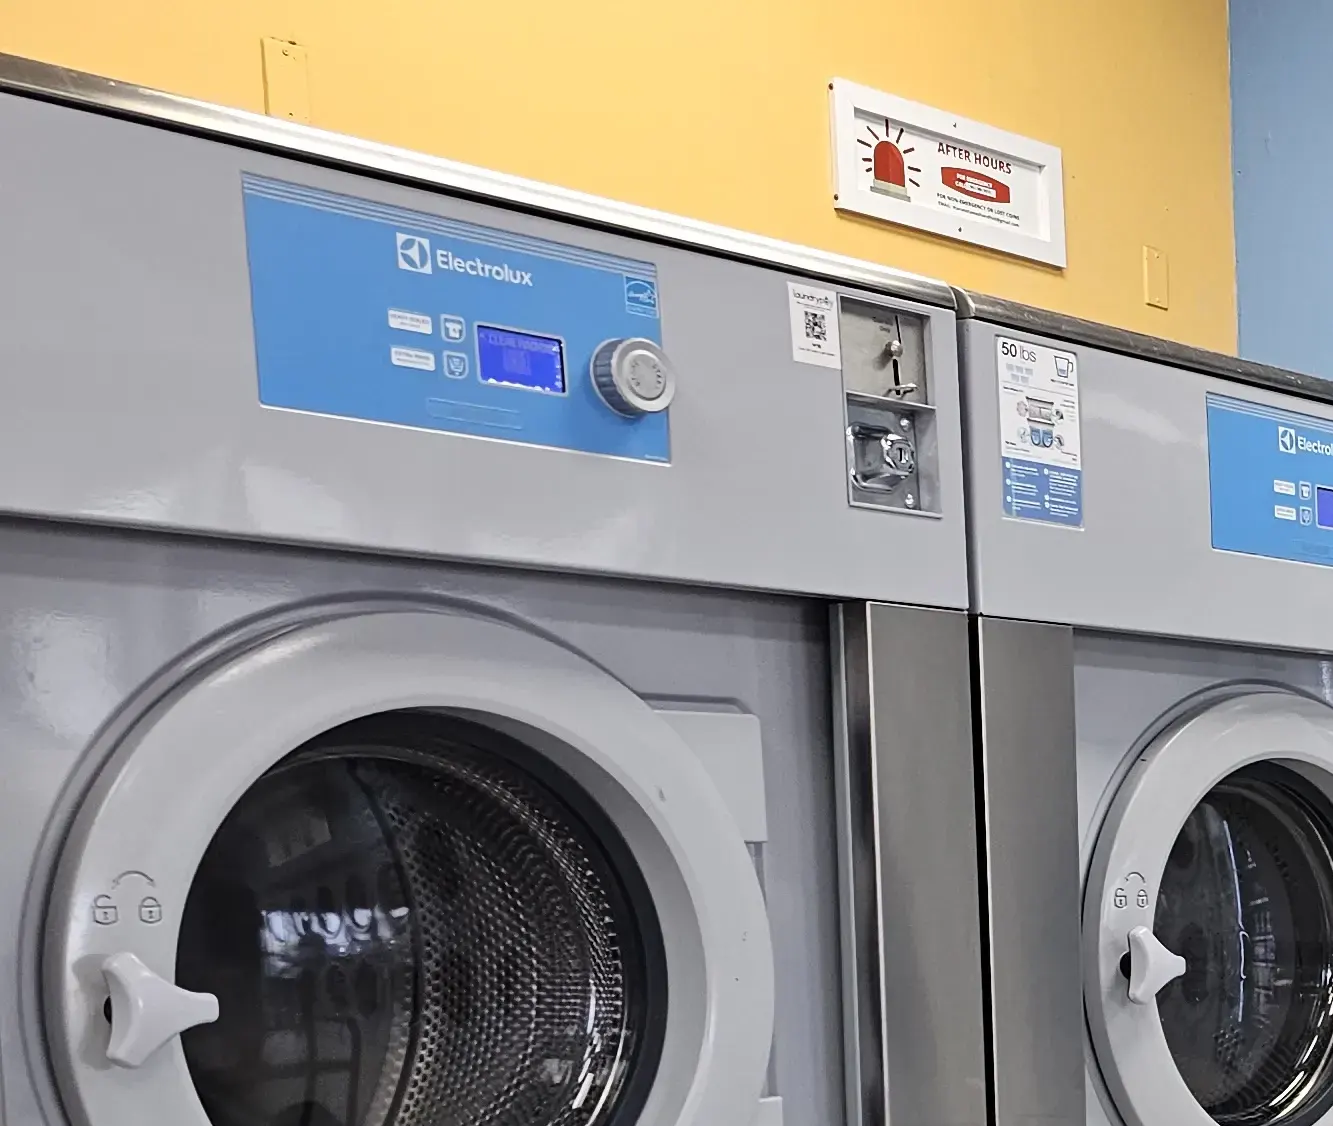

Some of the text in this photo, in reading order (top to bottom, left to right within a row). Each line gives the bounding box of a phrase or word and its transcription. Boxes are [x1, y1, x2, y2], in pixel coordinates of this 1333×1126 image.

[937, 142, 1012, 175] AFTER HOURS
[436, 249, 534, 287] Electrolux
[1001, 342, 1037, 362] 50 lbs
